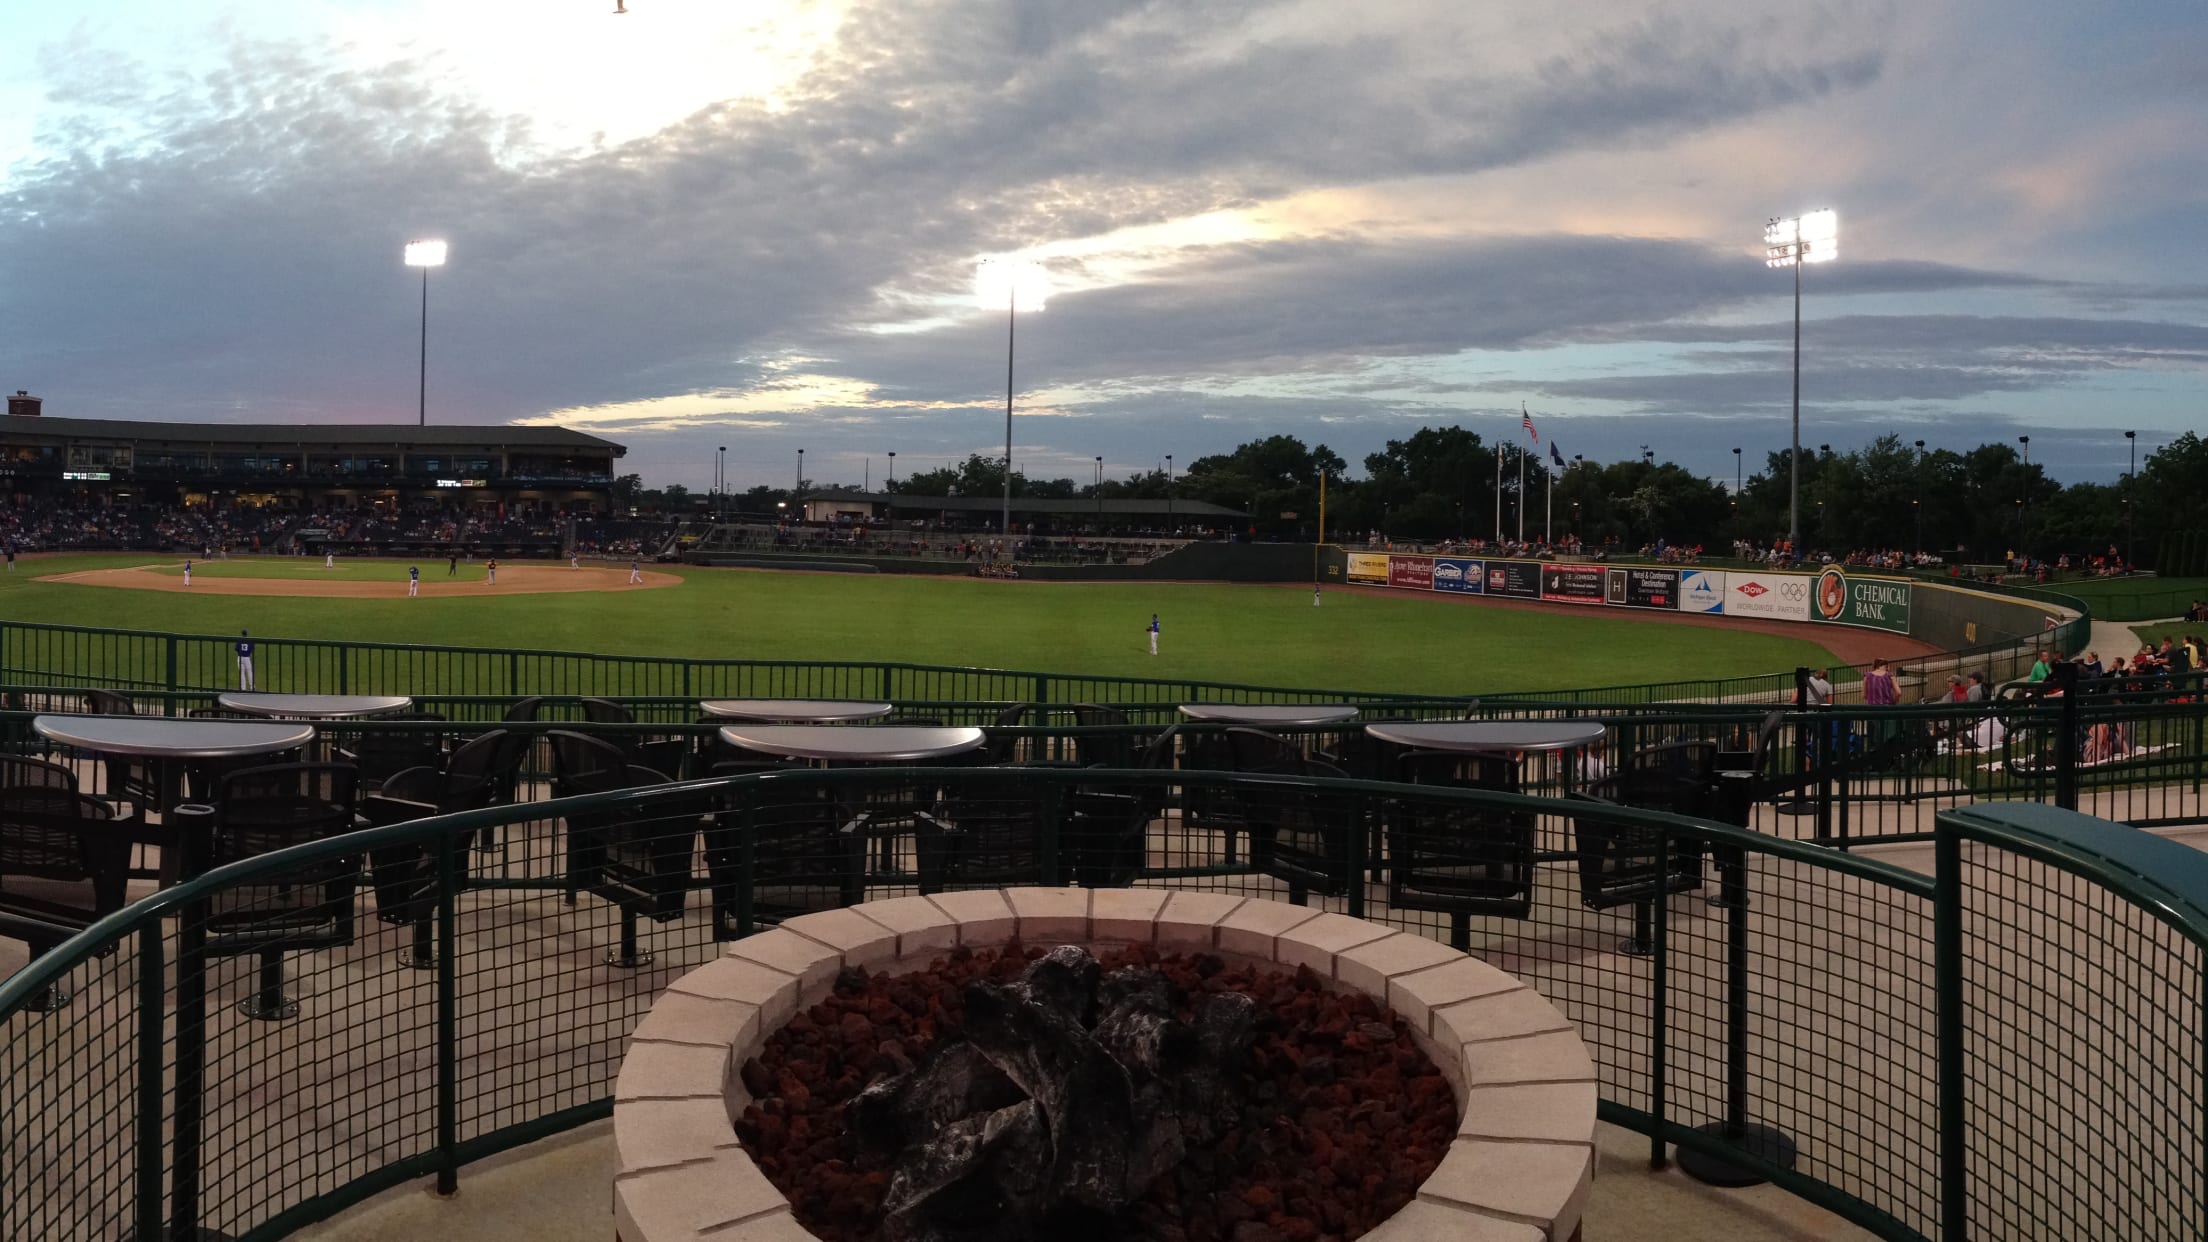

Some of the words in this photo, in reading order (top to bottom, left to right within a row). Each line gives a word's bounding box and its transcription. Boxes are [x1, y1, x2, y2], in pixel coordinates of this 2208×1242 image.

[1434, 567, 1462, 577] GARBER
[1632, 571, 1645, 579] Hotel
[1645, 571, 1649, 580] &
[1649, 571, 1675, 581] Conference
[1613, 581, 1621, 593] H
[1641, 579, 1667, 588] Destination
[1854, 584, 1908, 606] CHEMICAL
[1737, 603, 1774, 612] WORLDWIDE
[1777, 605, 1805, 614] PARTNER
